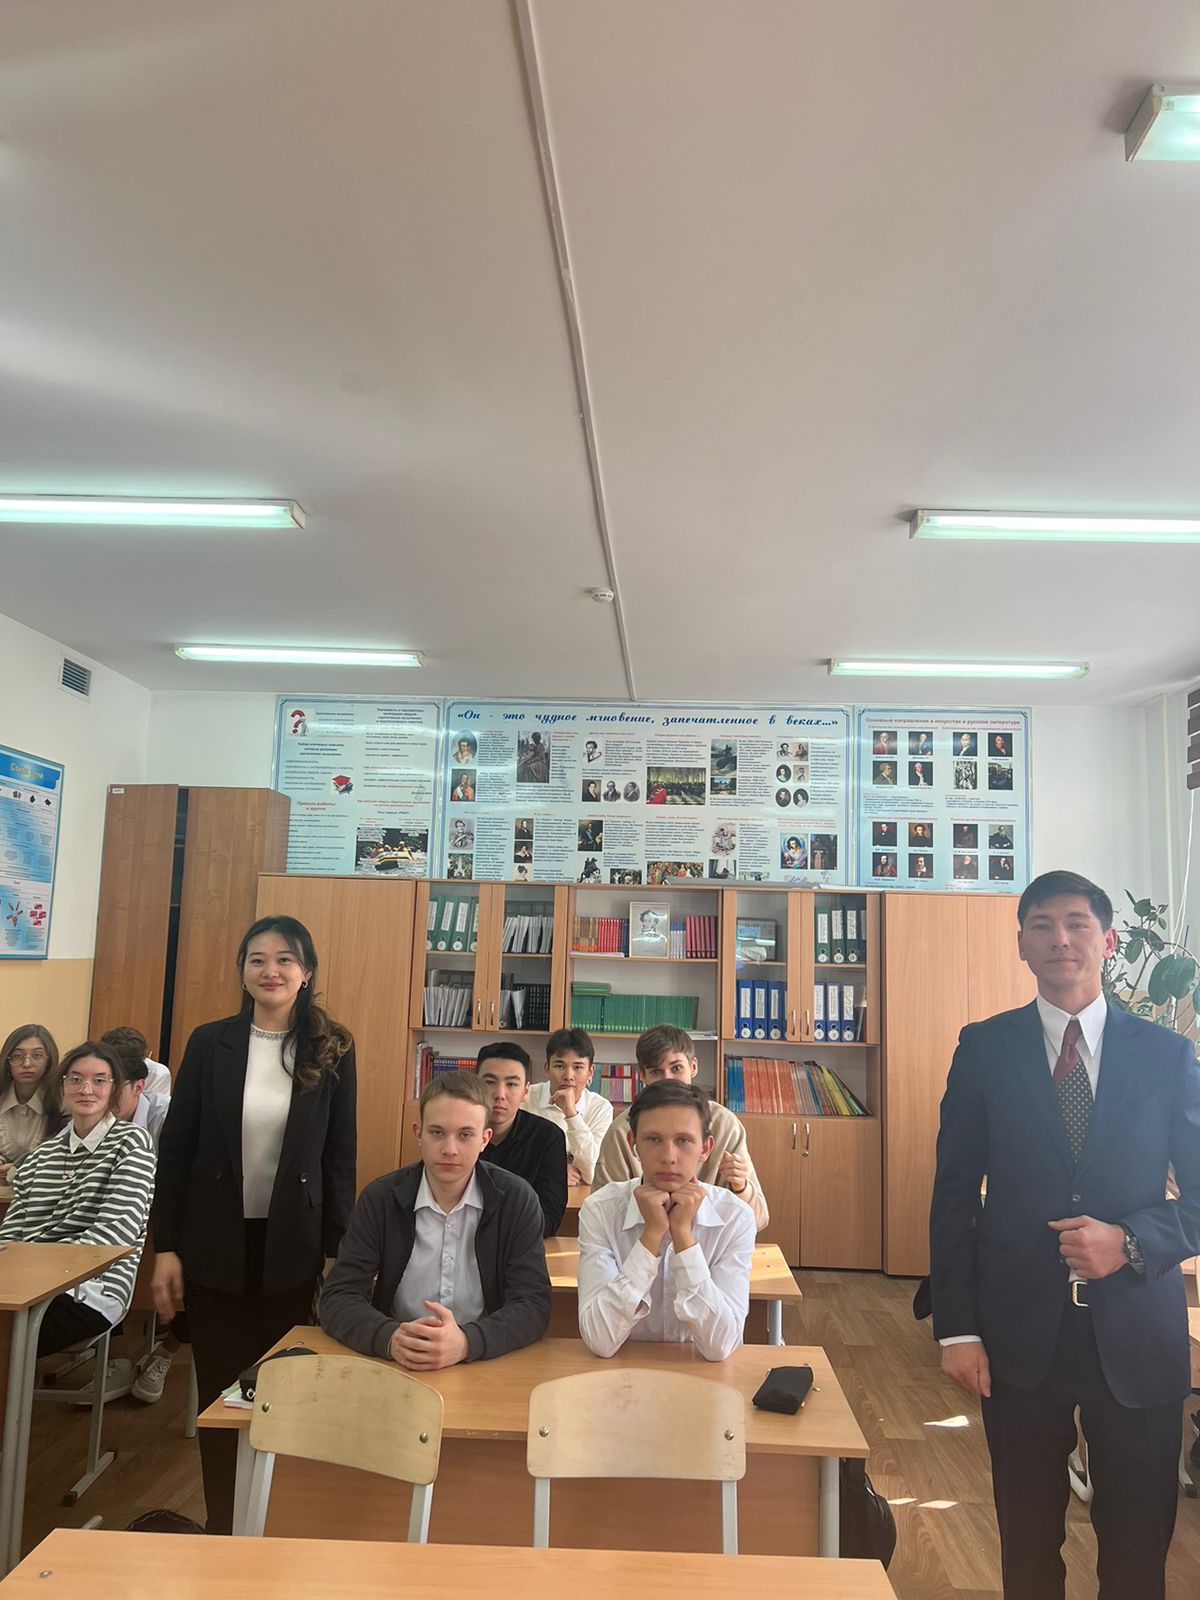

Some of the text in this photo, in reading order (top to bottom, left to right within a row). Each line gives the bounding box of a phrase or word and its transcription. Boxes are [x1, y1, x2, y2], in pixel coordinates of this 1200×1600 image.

[457, 710, 480, 720] «Он
[535, 713, 577, 723] чудное
[586, 711, 655, 725] мгновение,
[662, 716, 759, 727] запечатленное
[769, 714, 776, 725] в
